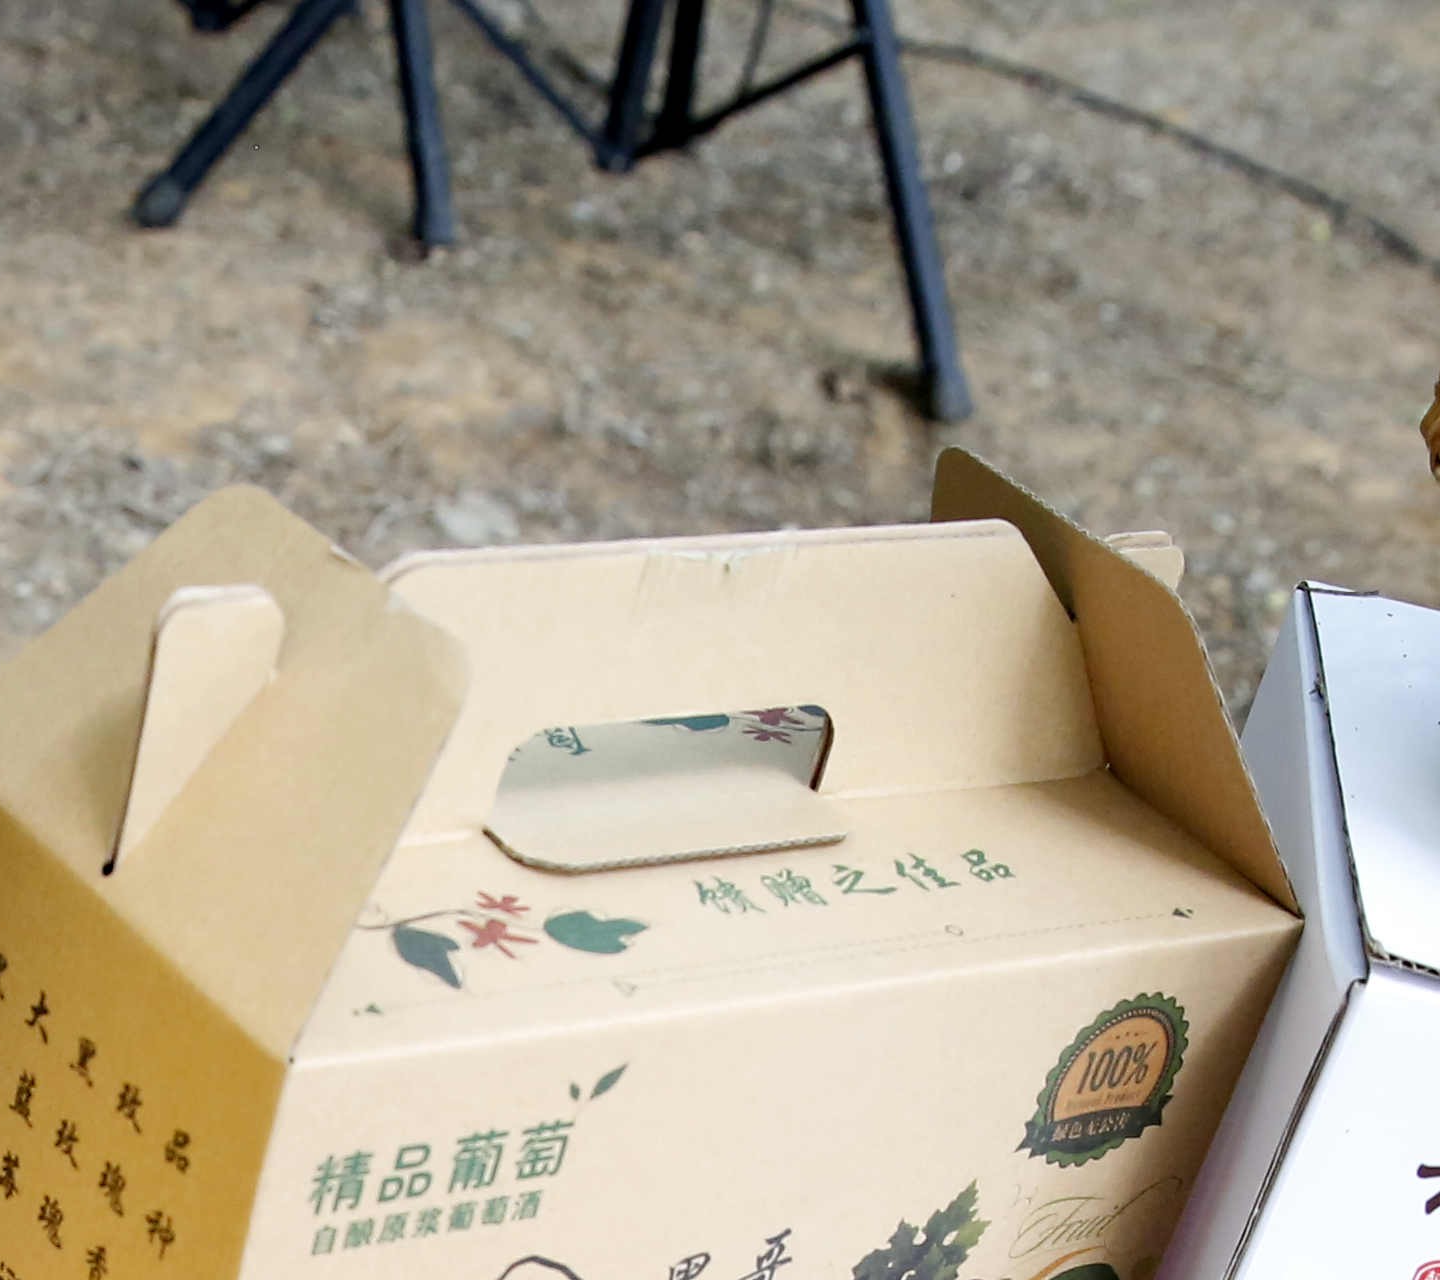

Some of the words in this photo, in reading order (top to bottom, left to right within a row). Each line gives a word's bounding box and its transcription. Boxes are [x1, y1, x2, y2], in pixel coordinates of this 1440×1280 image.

[1077, 1041, 1158, 1095] 100%
[309, 1118, 575, 1216] 精品葡萄
[311, 1190, 544, 1256] 自酿原浆葡萄酒
